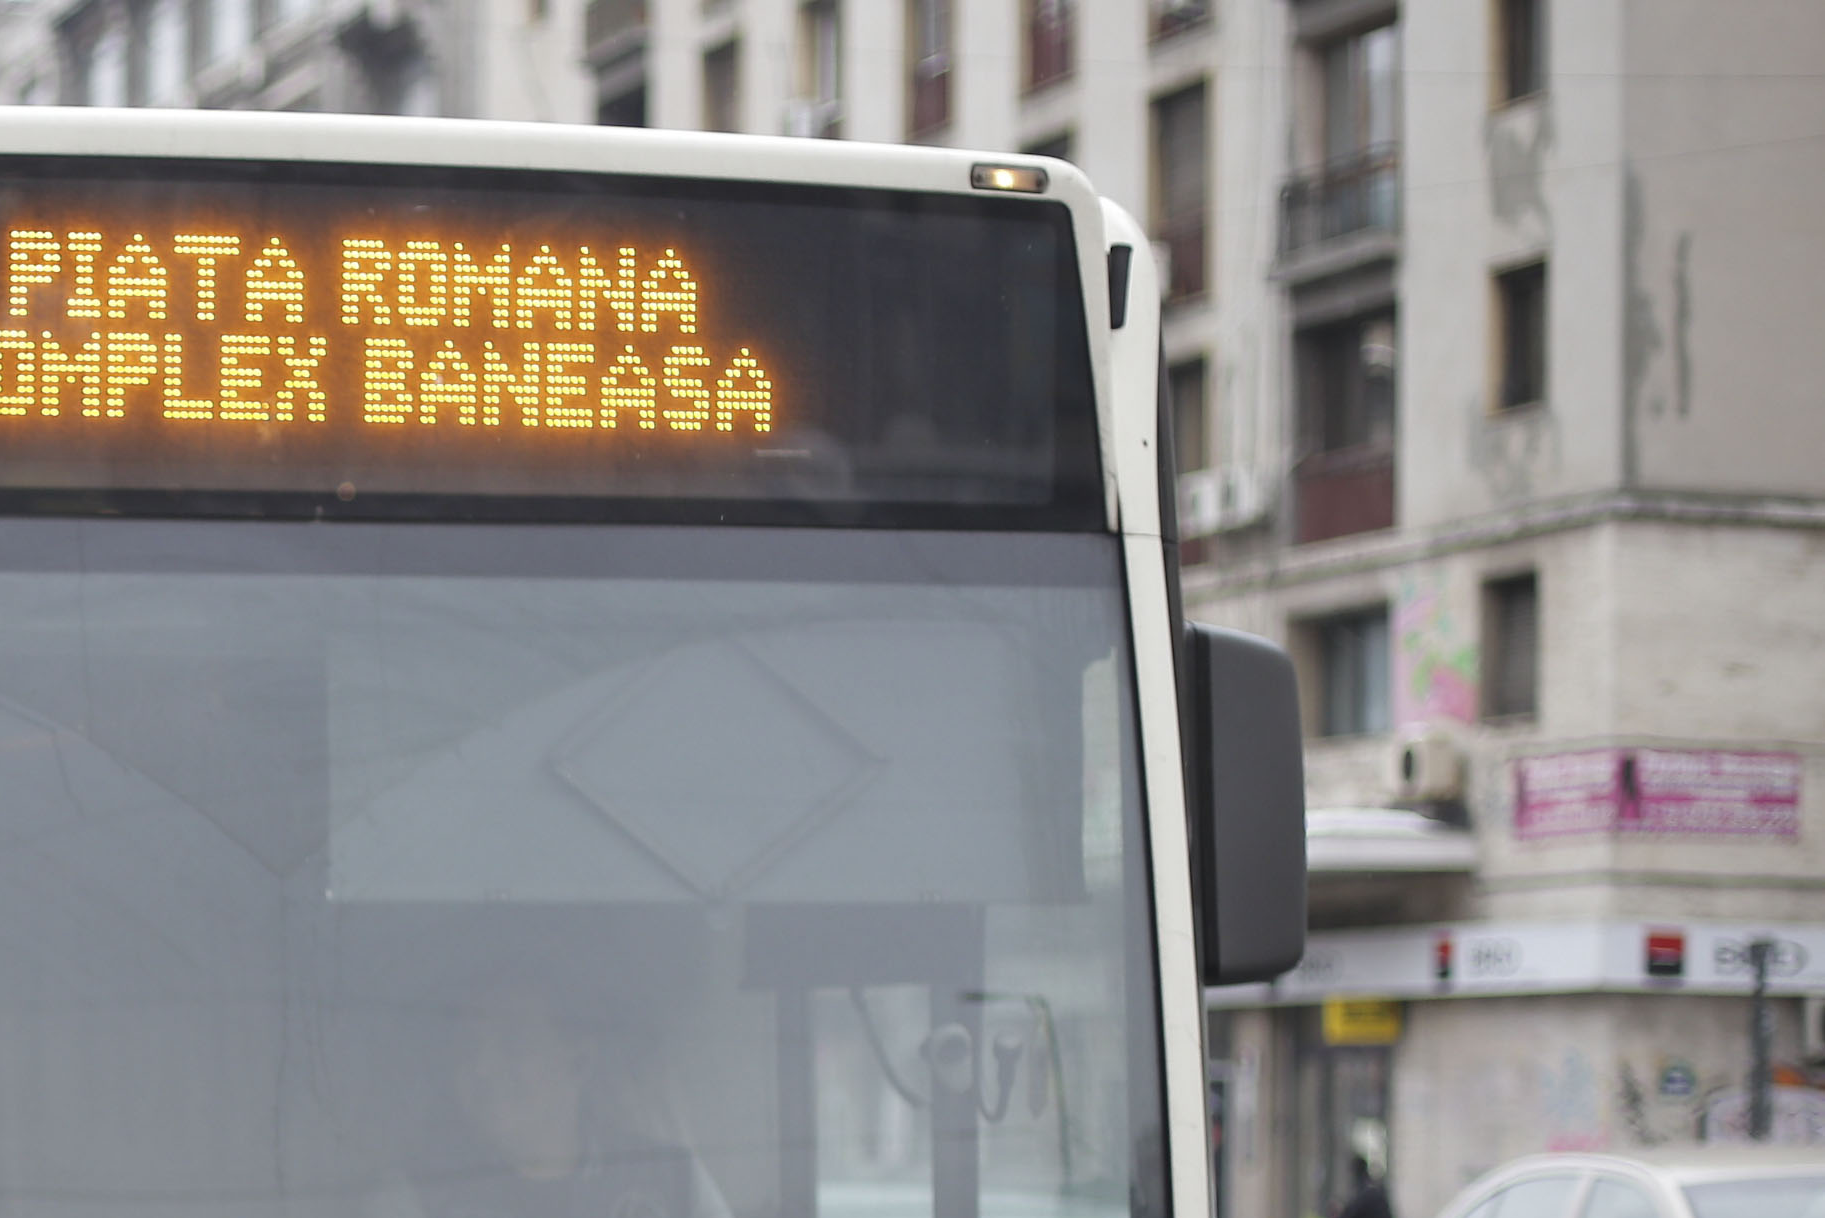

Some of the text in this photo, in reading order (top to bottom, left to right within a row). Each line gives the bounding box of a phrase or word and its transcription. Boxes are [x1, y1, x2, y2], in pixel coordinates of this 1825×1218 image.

[8, 229, 697, 334] PIATA ROMANA
[363, 337, 772, 432] BANEASA
